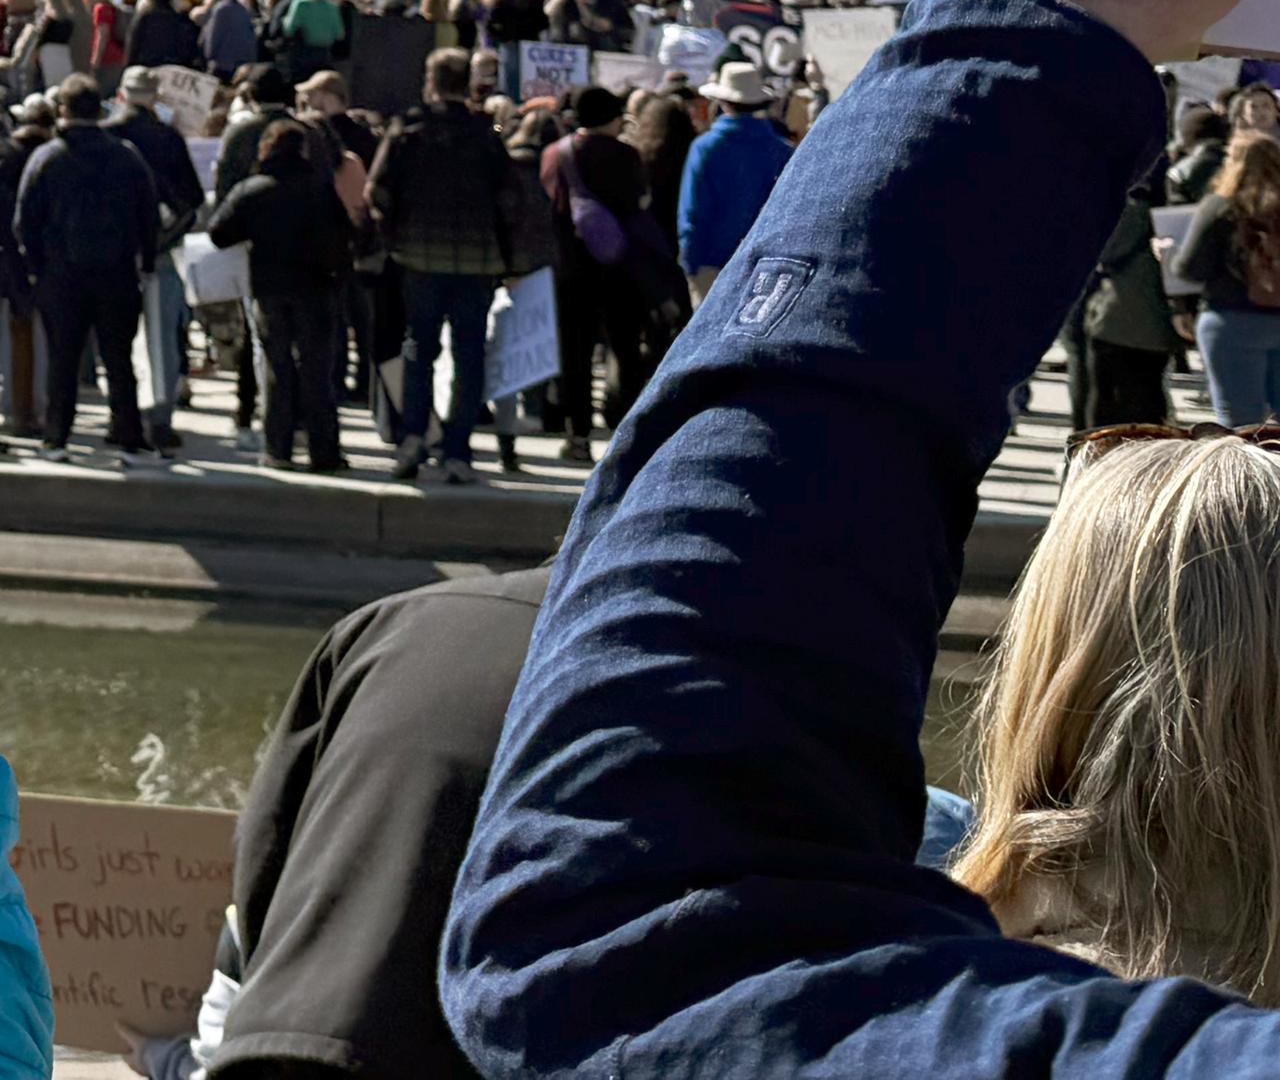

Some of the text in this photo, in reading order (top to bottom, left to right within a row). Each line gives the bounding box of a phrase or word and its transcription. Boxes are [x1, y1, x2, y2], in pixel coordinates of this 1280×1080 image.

[535, 65, 574, 84] NOT
[92, 831, 160, 886] just
[52, 902, 188, 940] FUNDING
